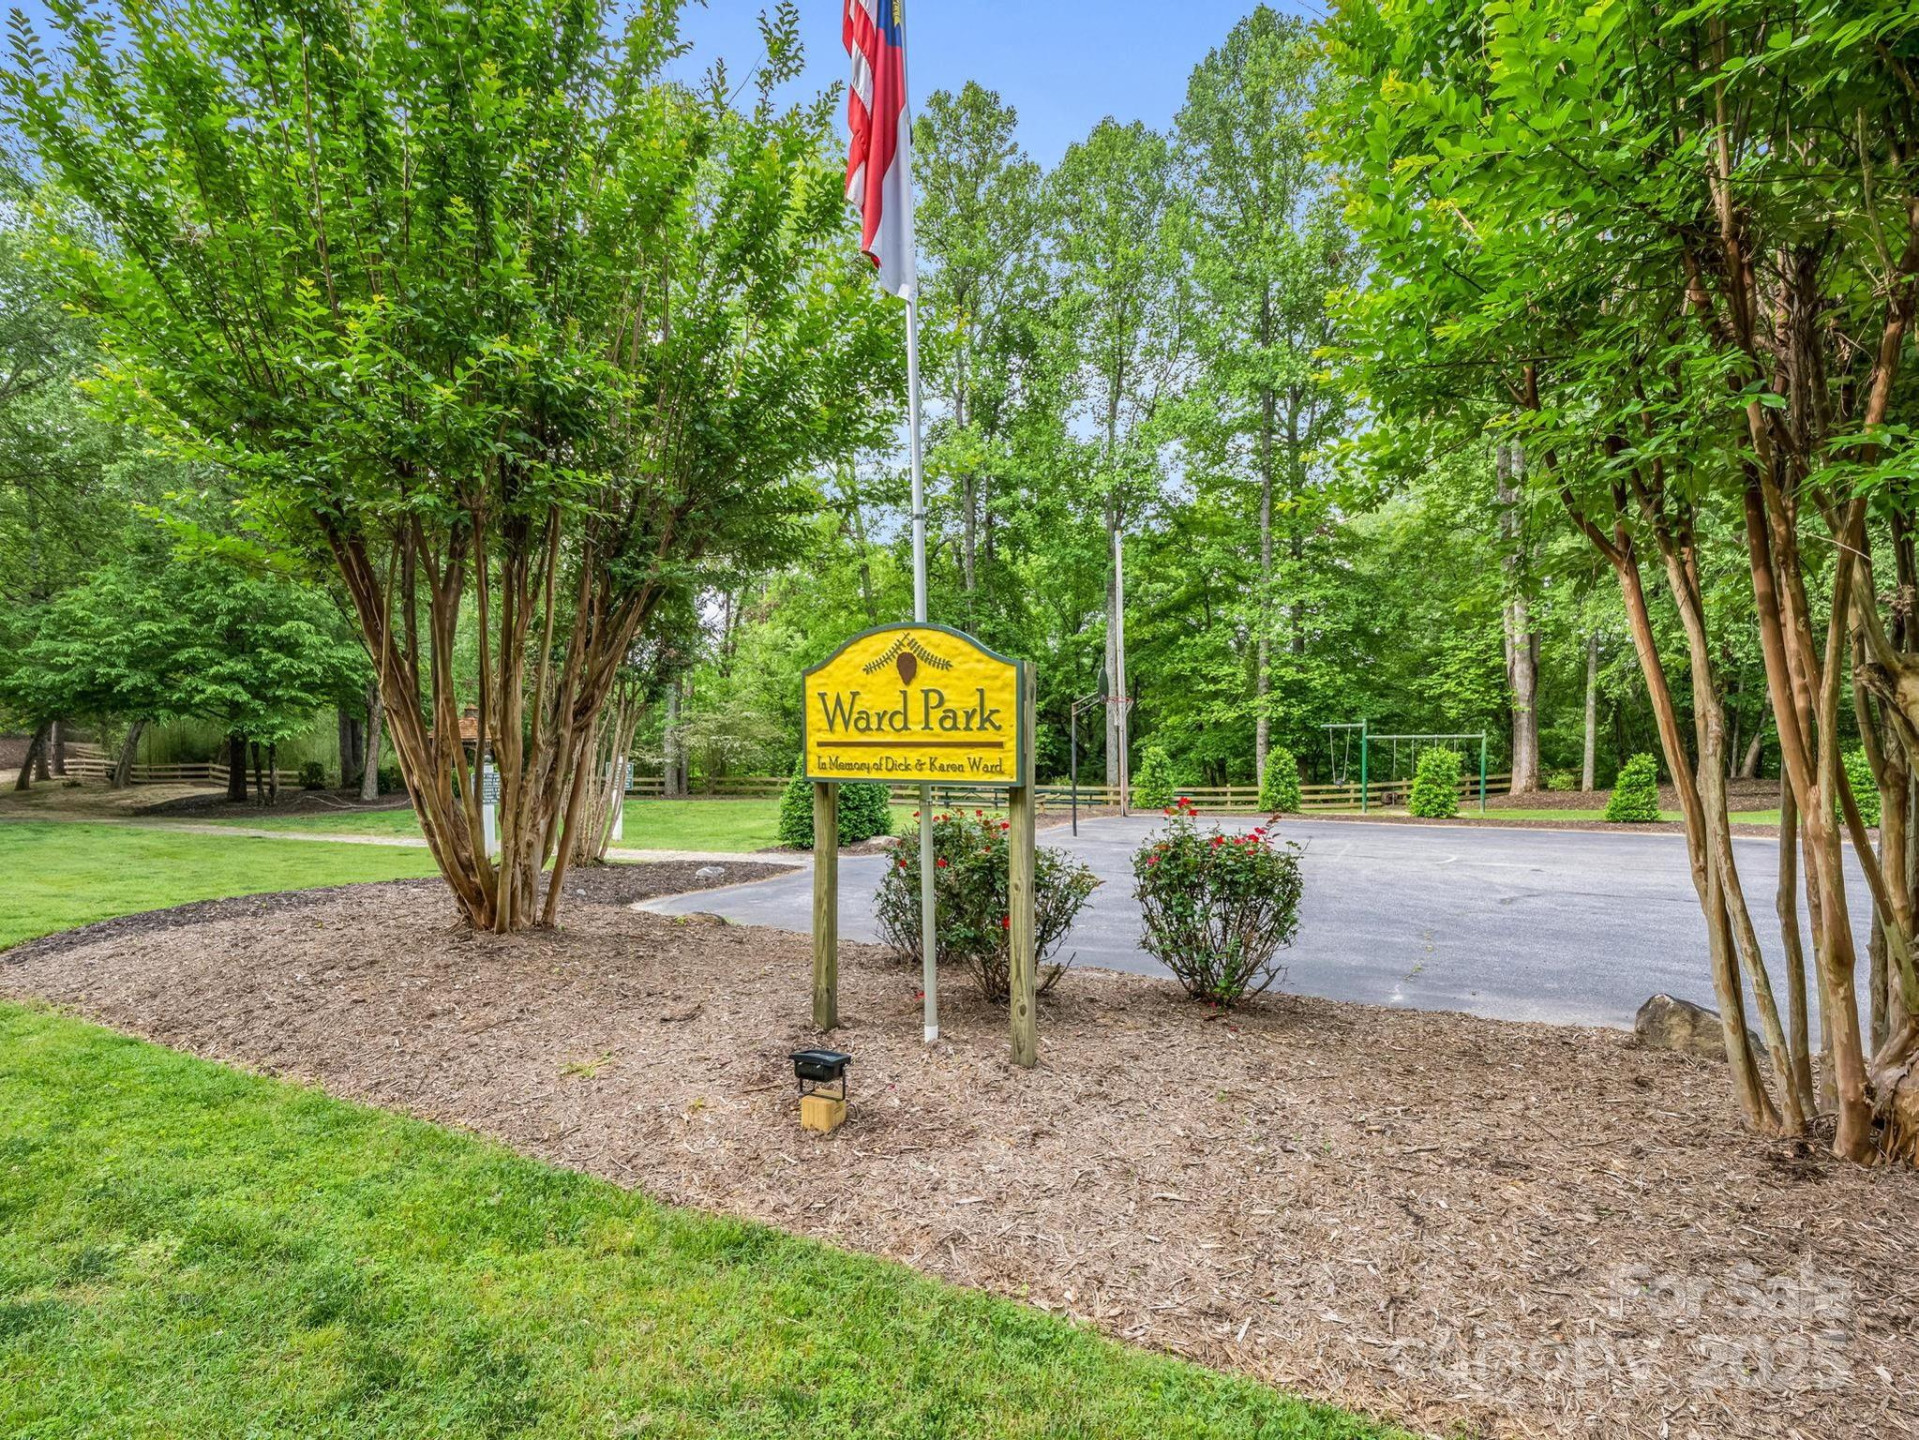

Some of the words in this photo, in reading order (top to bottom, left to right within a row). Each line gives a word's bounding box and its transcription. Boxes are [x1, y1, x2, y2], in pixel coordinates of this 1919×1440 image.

[816, 689, 912, 733] Ward
[920, 687, 1003, 732] Park
[817, 756, 827, 770] In
[828, 755, 870, 774] Memory
[872, 756, 885, 771] of
[885, 756, 912, 772] Dick
[915, 758, 927, 771] &
[929, 756, 965, 773] Karen
